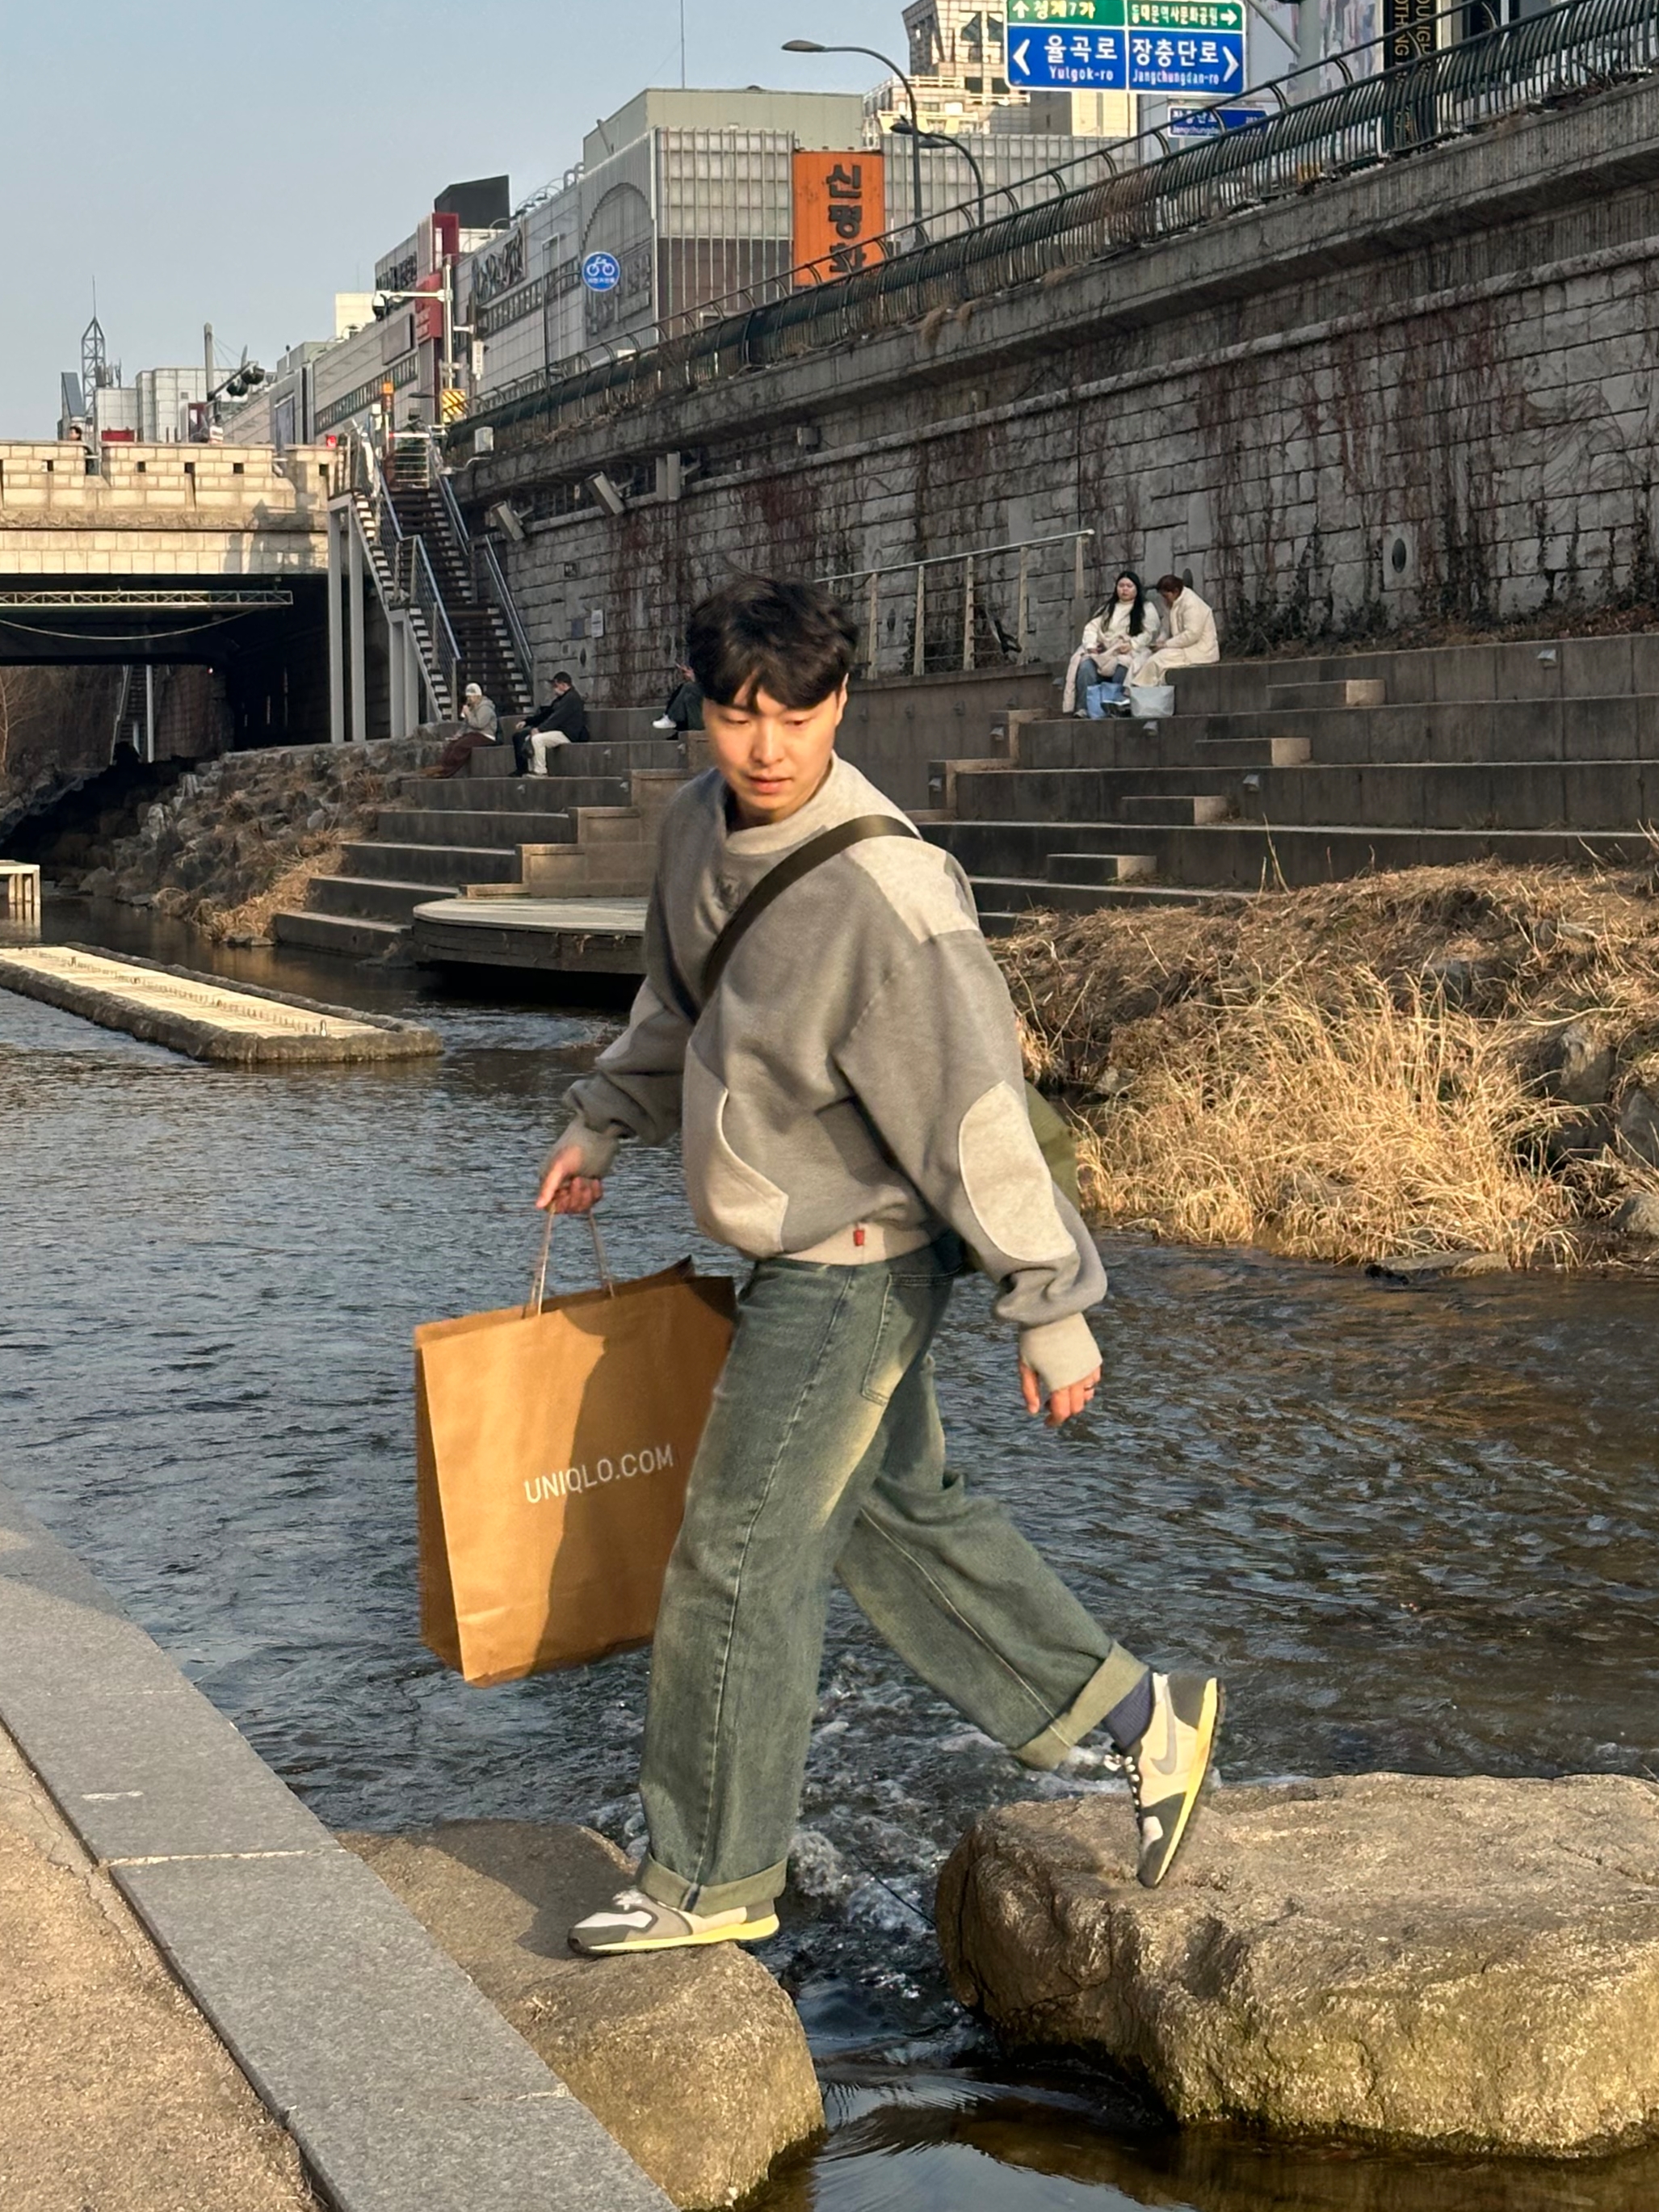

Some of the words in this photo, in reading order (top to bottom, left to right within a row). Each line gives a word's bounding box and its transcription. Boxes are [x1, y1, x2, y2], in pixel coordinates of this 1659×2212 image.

[1132, 4, 1218, 27] 동대문역사문화공원
[1044, 35, 1118, 64] 율곡로
[1132, 38, 1220, 68] 장충단로
[1049, 65, 1114, 82] Yulgok-ro
[1132, 69, 1220, 86] Jangchungdan-ro
[826, 164, 867, 273] 신평화
[523, 1444, 674, 1503] UNIQLO.COM
